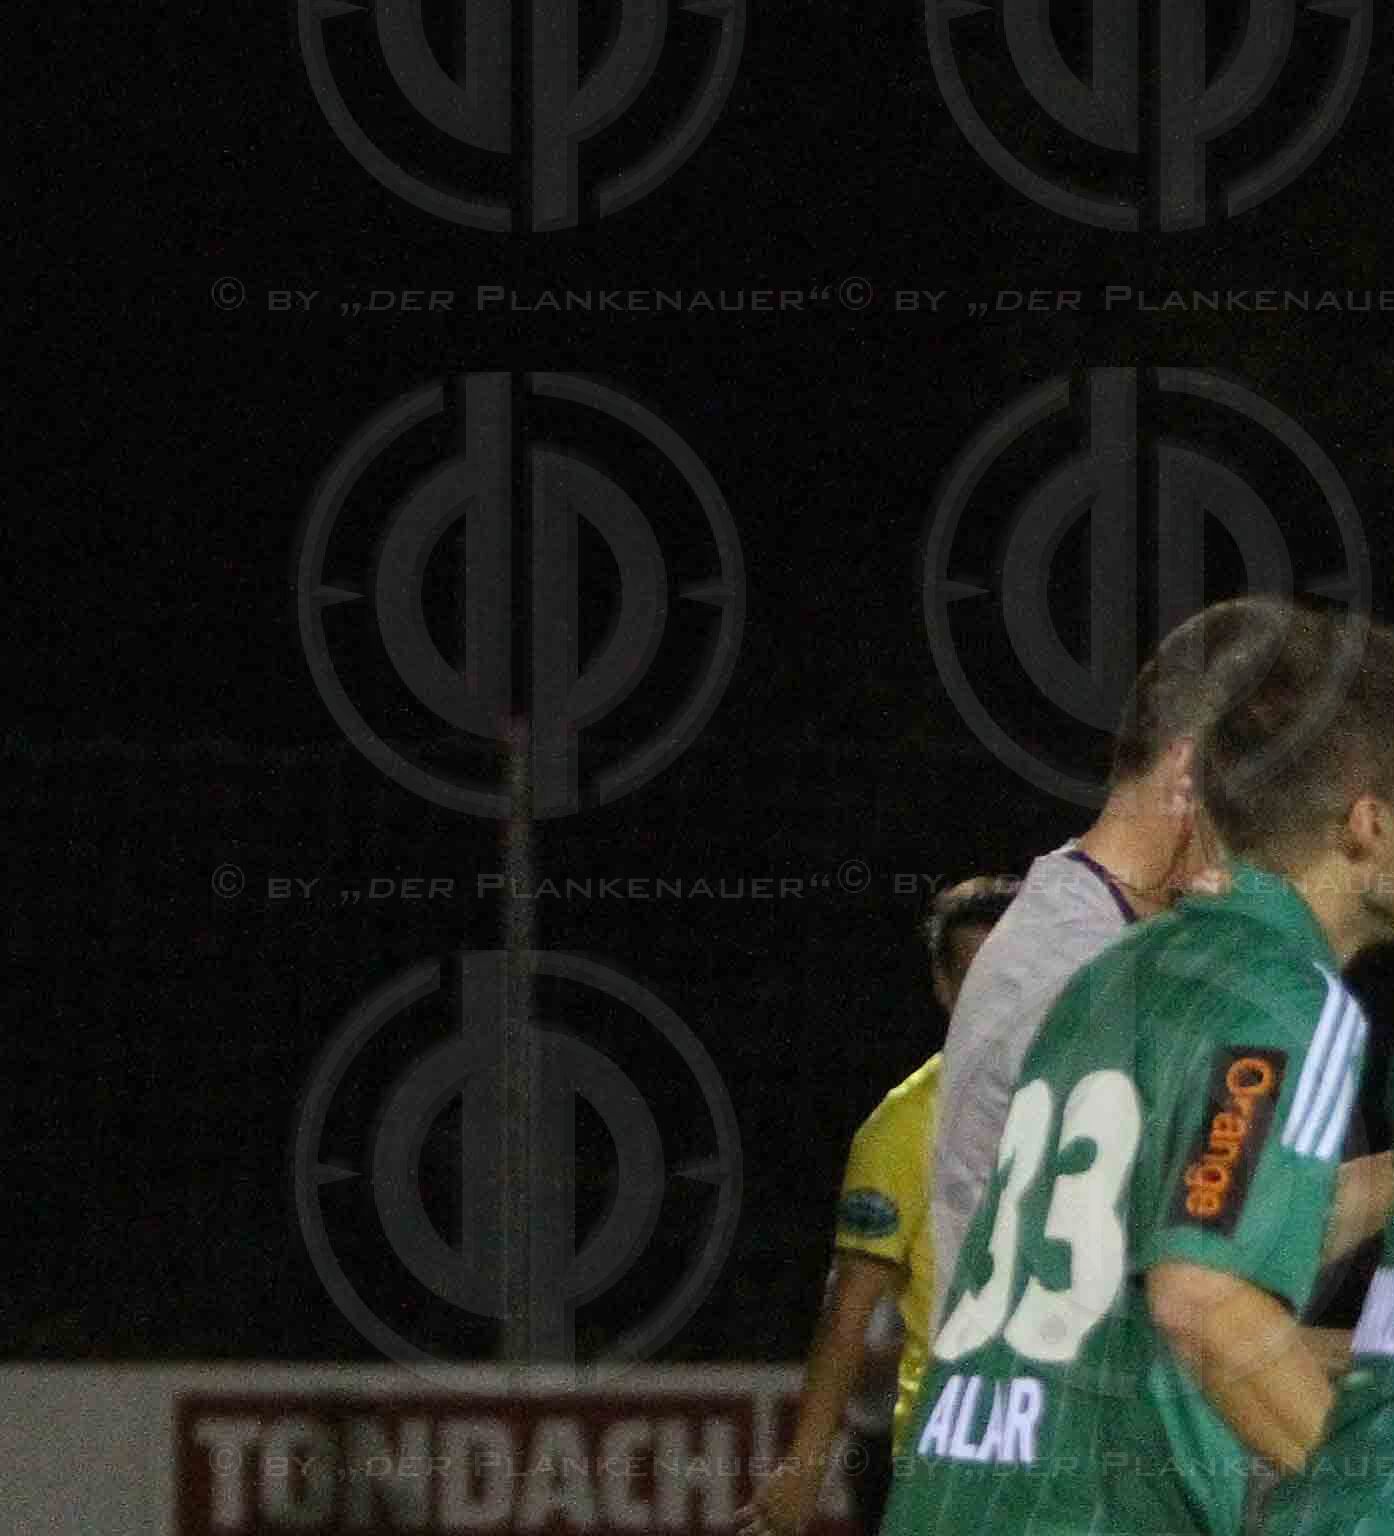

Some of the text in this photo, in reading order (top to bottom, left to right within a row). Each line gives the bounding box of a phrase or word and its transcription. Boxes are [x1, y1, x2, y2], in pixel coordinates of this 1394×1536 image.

[934, 1069, 1142, 1363] 33
[195, 1415, 724, 1530] TONDACH
[918, 1375, 1042, 1463] ALAR
